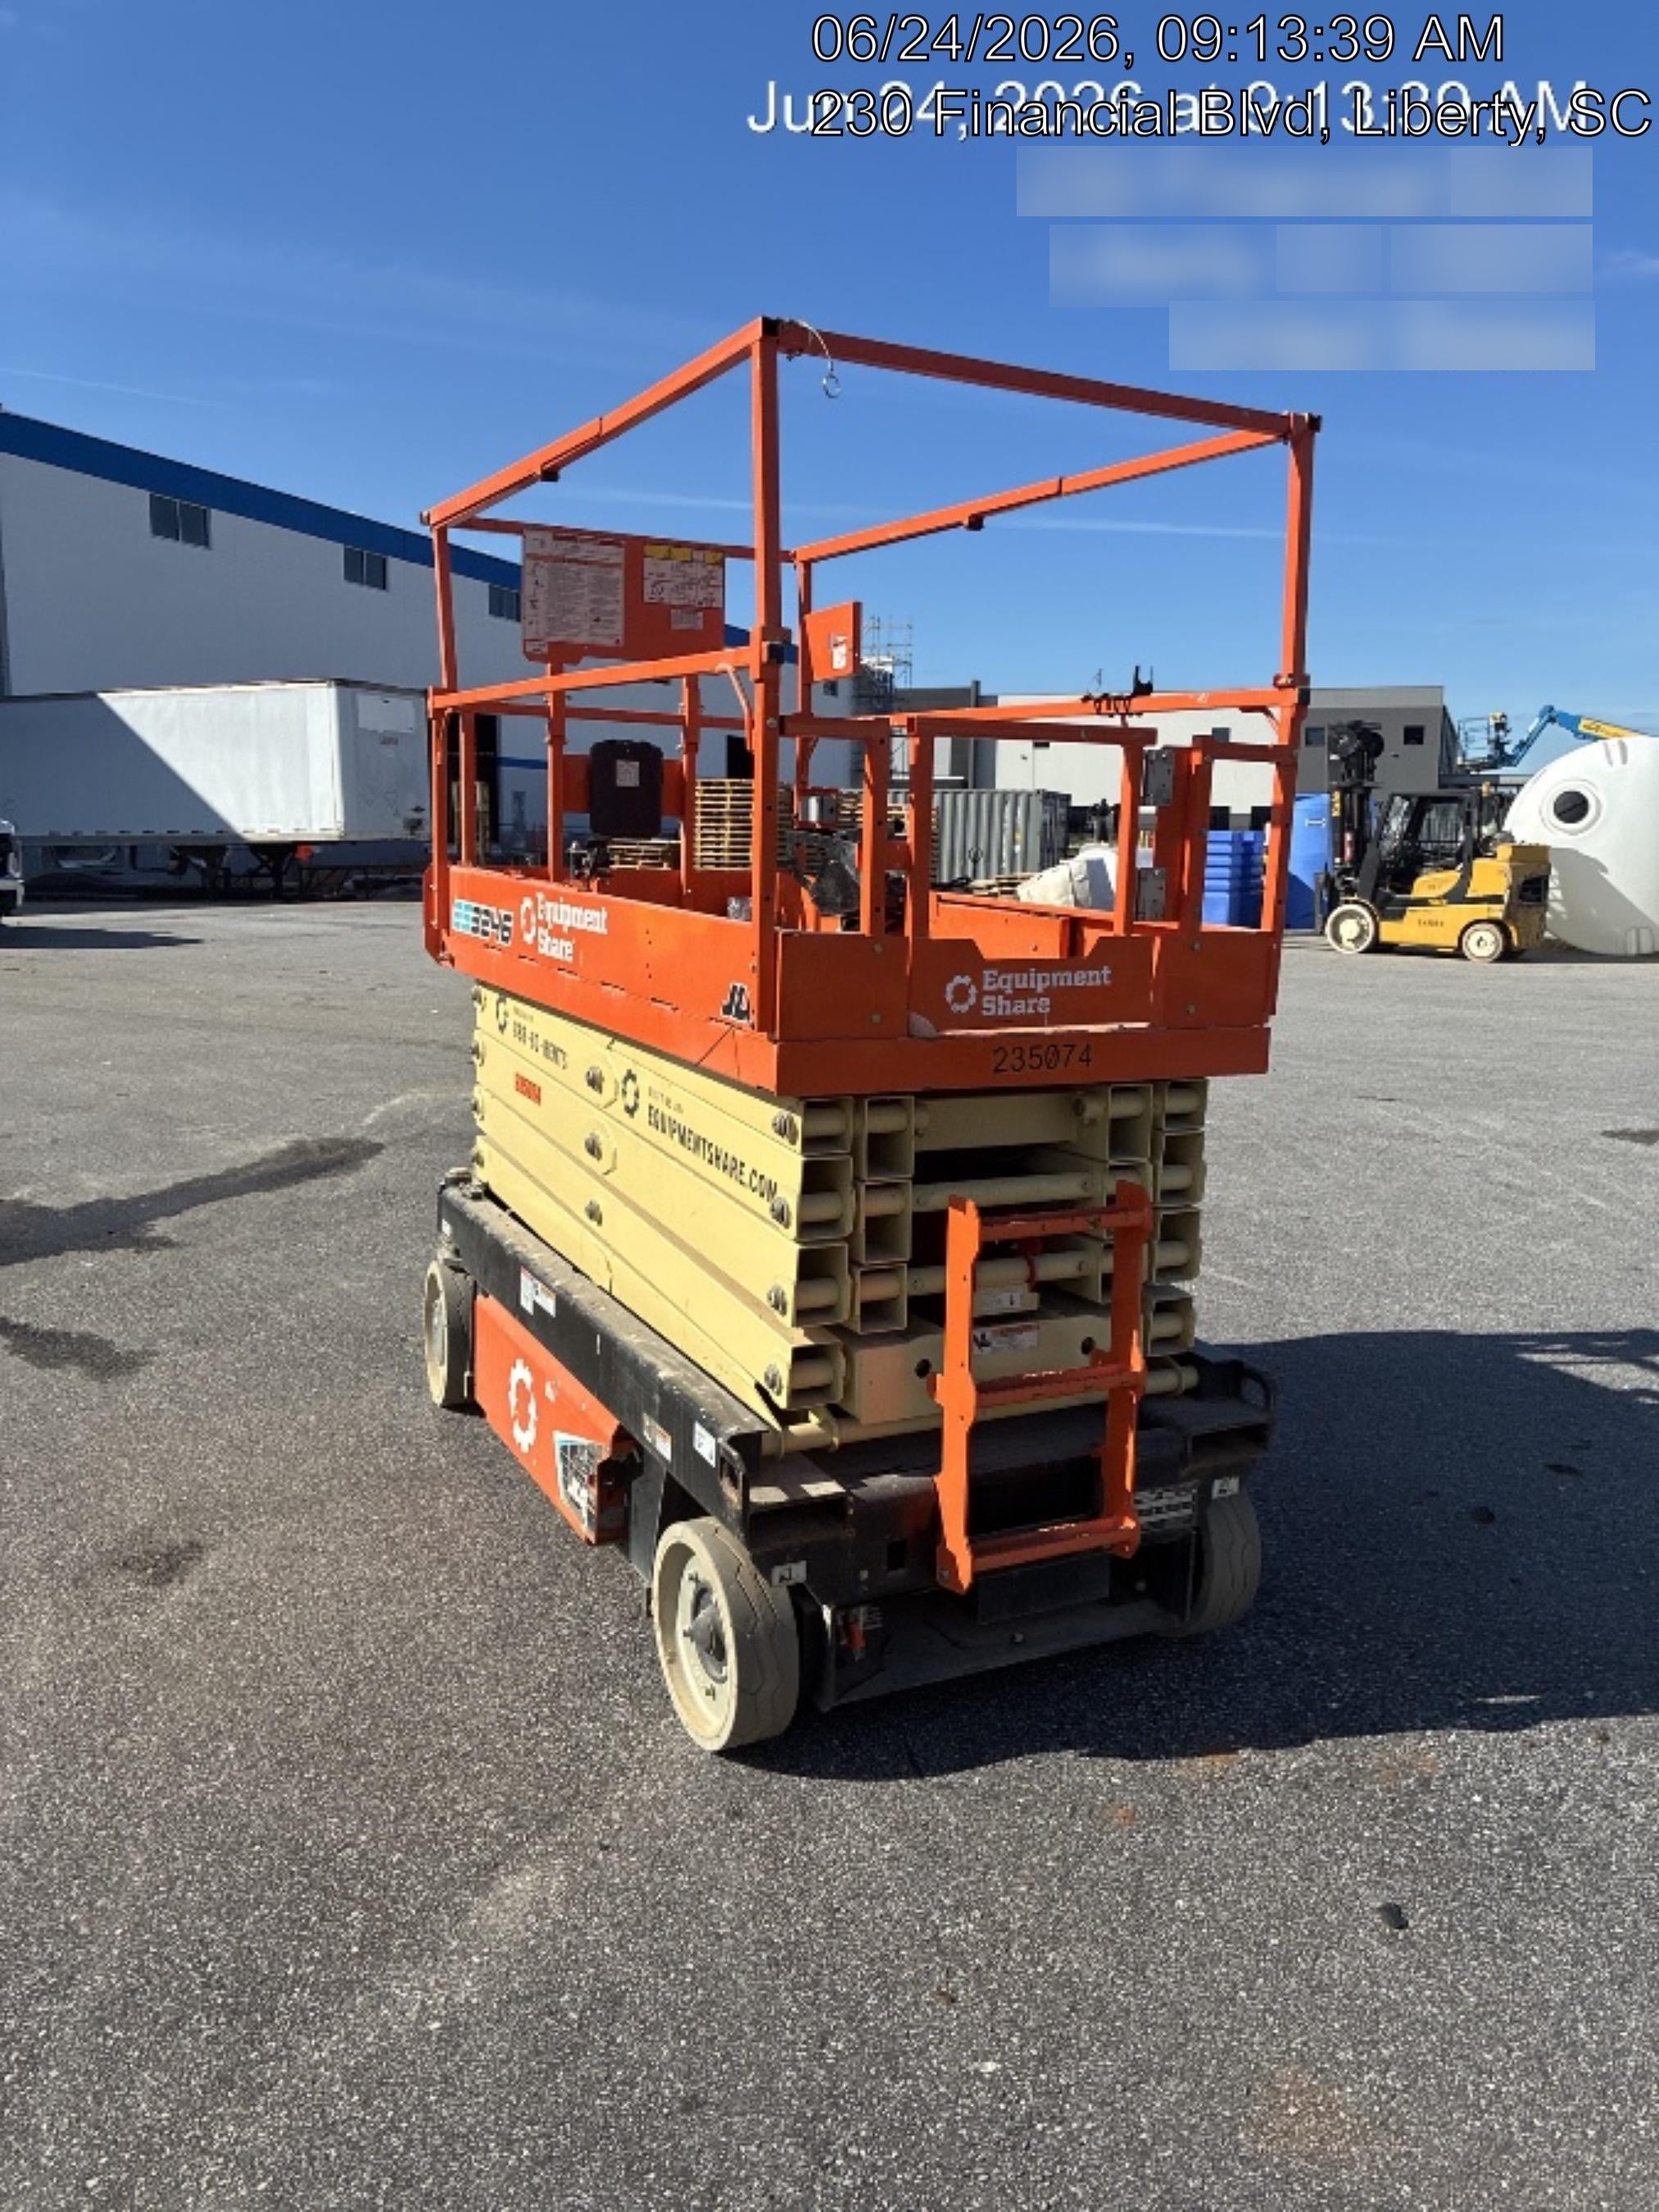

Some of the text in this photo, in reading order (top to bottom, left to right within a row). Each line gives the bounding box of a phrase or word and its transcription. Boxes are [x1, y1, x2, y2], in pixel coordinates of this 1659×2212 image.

[537, 892, 608, 935] Equipment
[537, 927, 575, 963] Share
[982, 965, 1112, 994] Equipment
[981, 995, 1051, 1017] Share
[993, 1044, 1093, 1073] 235074
